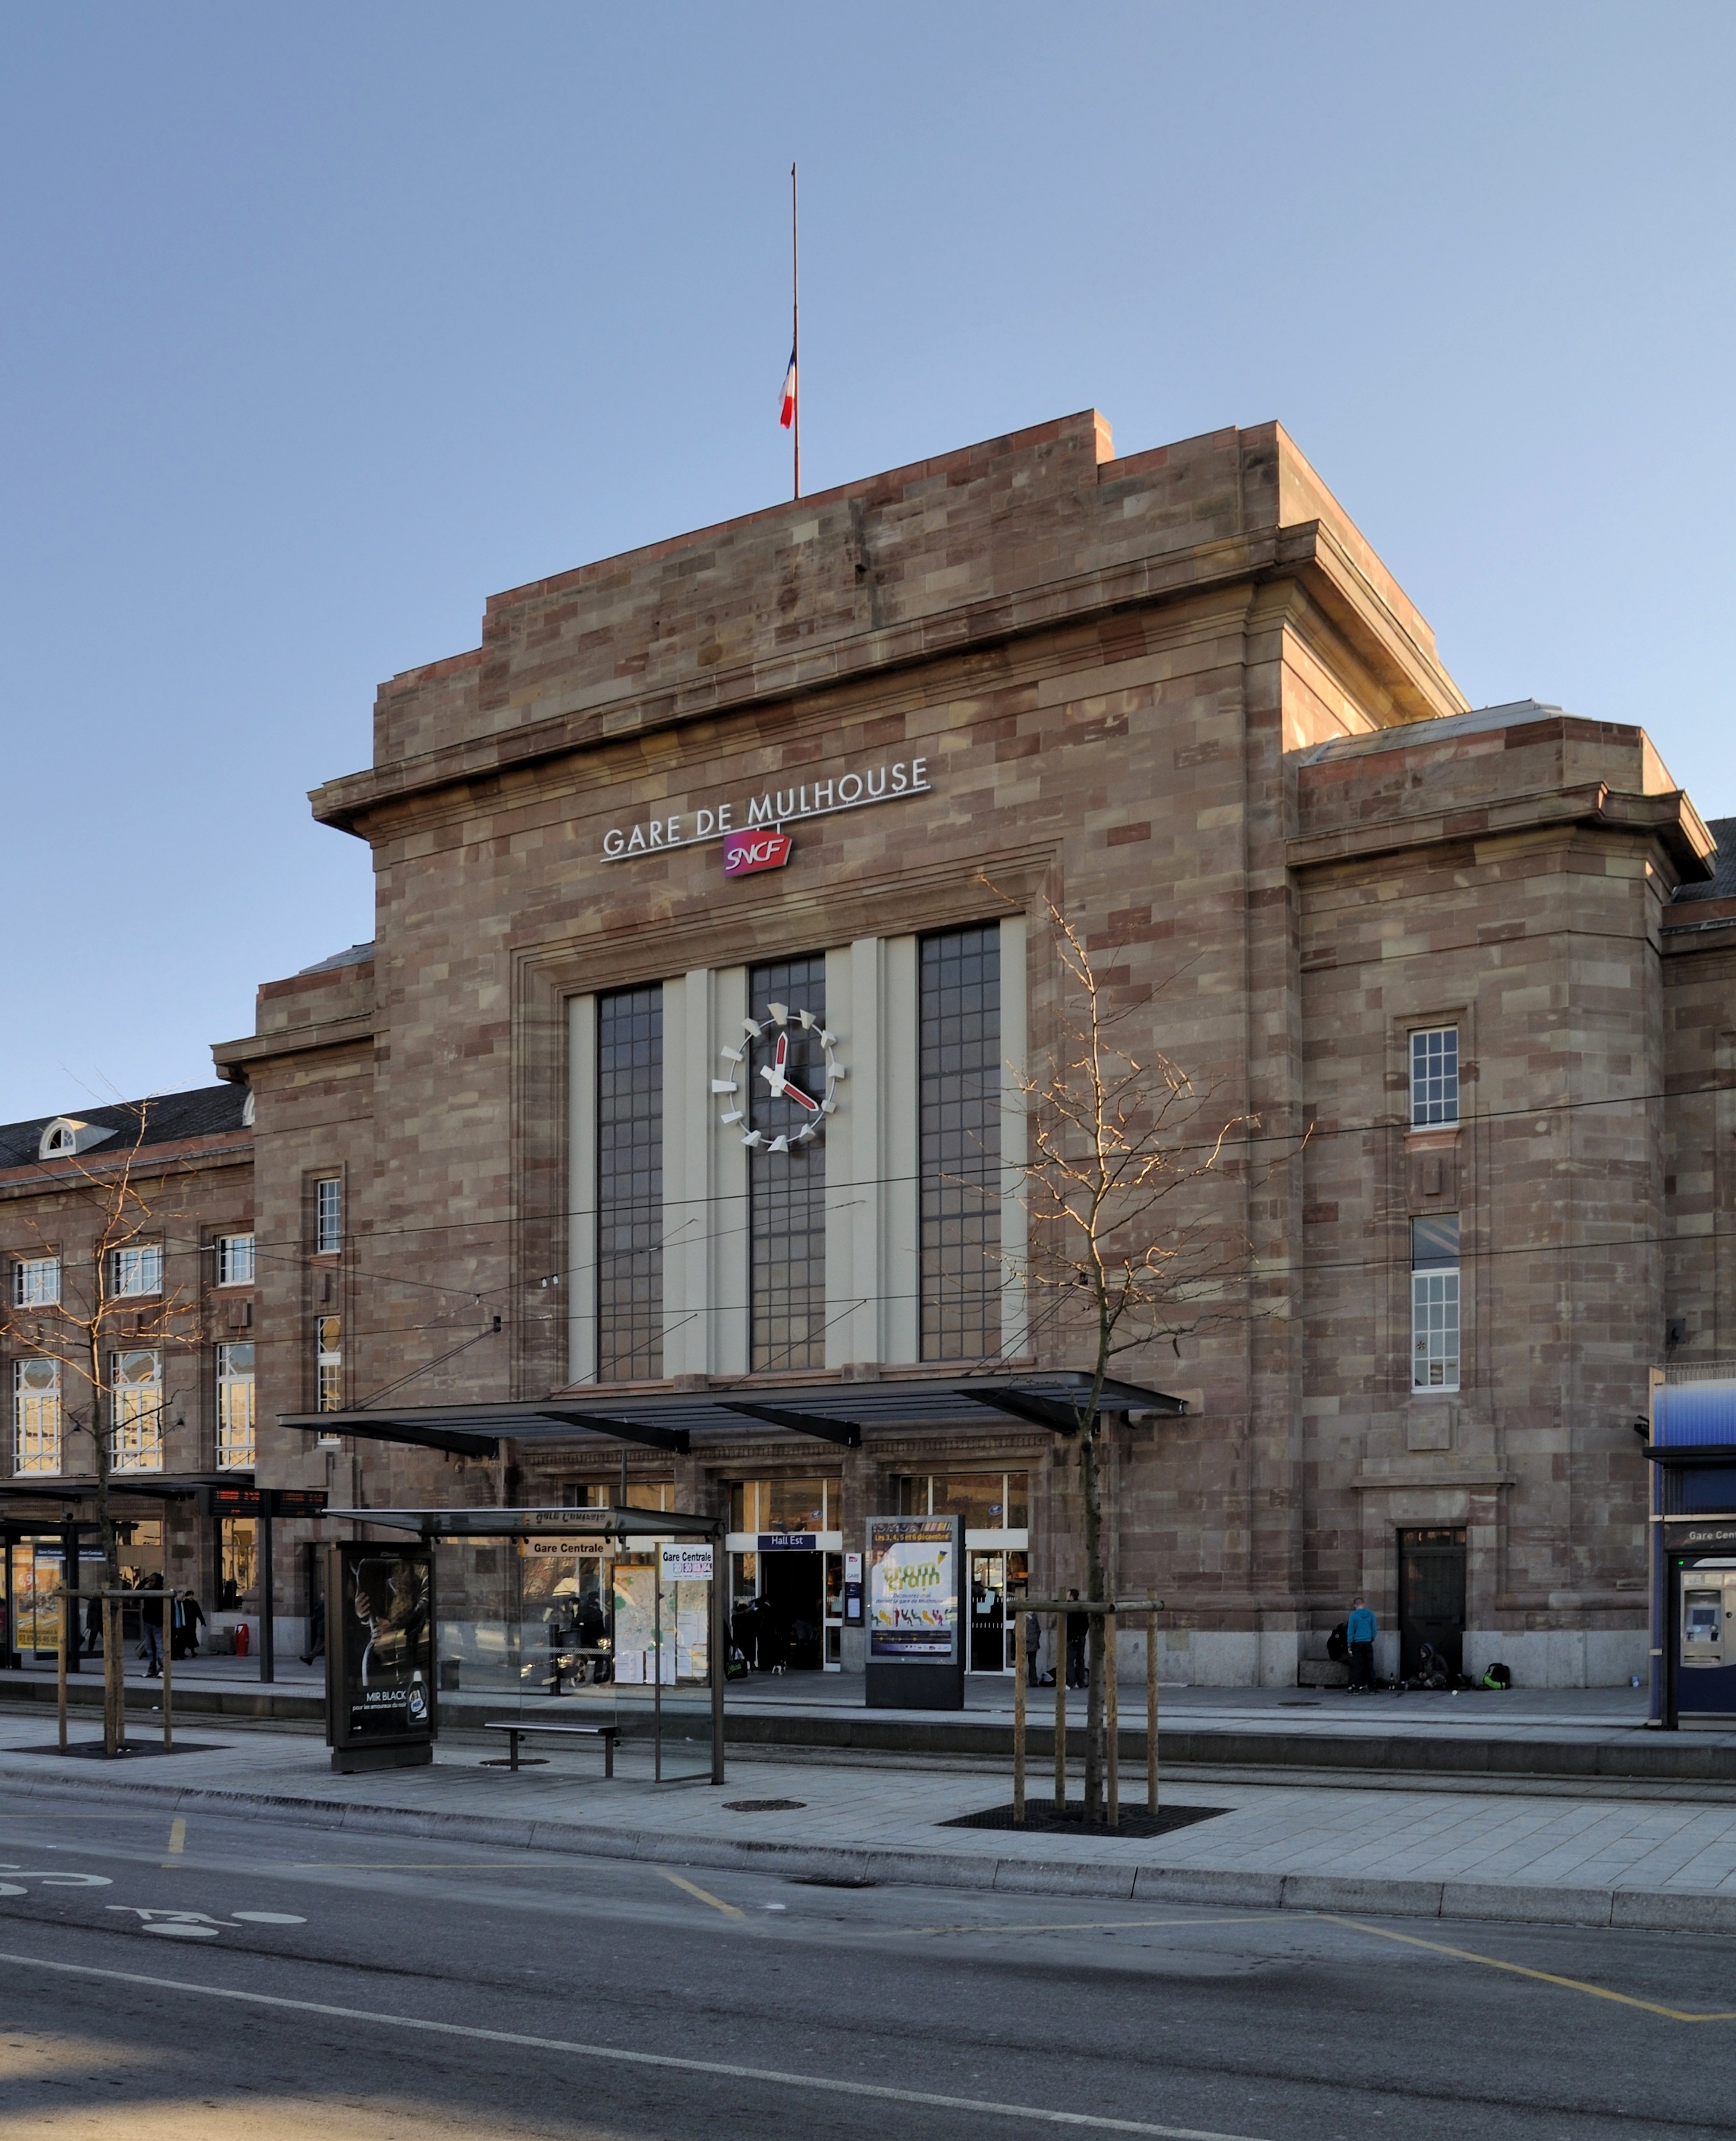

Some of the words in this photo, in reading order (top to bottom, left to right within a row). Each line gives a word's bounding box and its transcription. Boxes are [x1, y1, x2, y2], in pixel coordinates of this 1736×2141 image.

[603, 815, 681, 856] GARE
[697, 804, 732, 836] DE
[747, 757, 927, 824] MULHOUSE
[724, 838, 785, 870] SNCF
[771, 1536, 788, 1545] Hall
[790, 1536, 804, 1545] Est
[1689, 1531, 1713, 1540] Gare
[534, 1543, 558, 1553] Gare
[560, 1543, 604, 1553] Centrale
[663, 1552, 680, 1561] Gare
[682, 1552, 711, 1561] Centrale
[366, 1691, 381, 1702] MIR
[382, 1690, 407, 1701] BLACK
